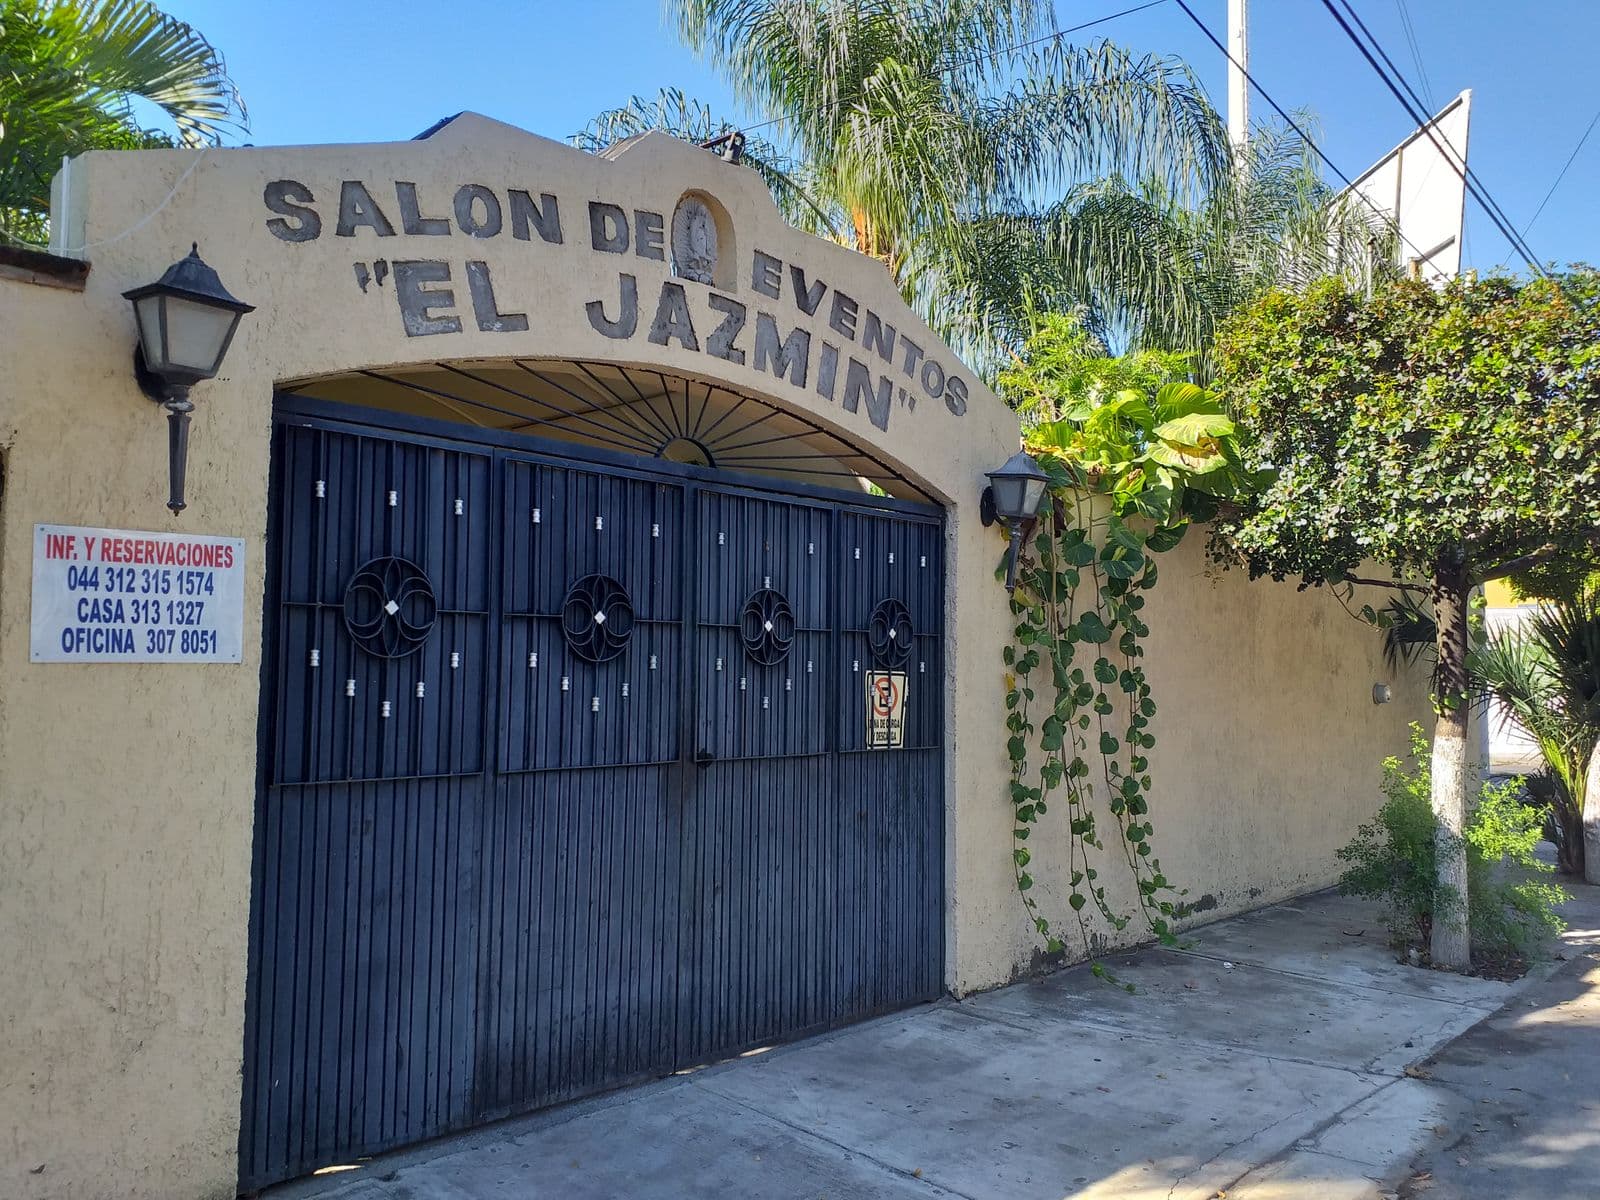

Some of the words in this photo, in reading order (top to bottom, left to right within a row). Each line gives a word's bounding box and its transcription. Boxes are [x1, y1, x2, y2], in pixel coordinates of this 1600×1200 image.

[264, 180, 564, 244] SALON
[588, 201, 665, 261] DE
[752, 249, 969, 416] EVENTOS
[46, 534, 77, 560] INF.
[84, 537, 96, 561] Y
[101, 537, 234, 568] RESERVACIONES
[67, 565, 99, 592] 044
[105, 567, 136, 593] 312
[141, 569, 171, 595] 315
[176, 571, 214, 596] 1574
[77, 598, 125, 624] CASA
[131, 599, 161, 624] 313
[166, 601, 204, 625] 1327
[61, 627, 135, 654] OFICINA
[146, 629, 176, 654] 307
[181, 629, 217, 654] 8051
